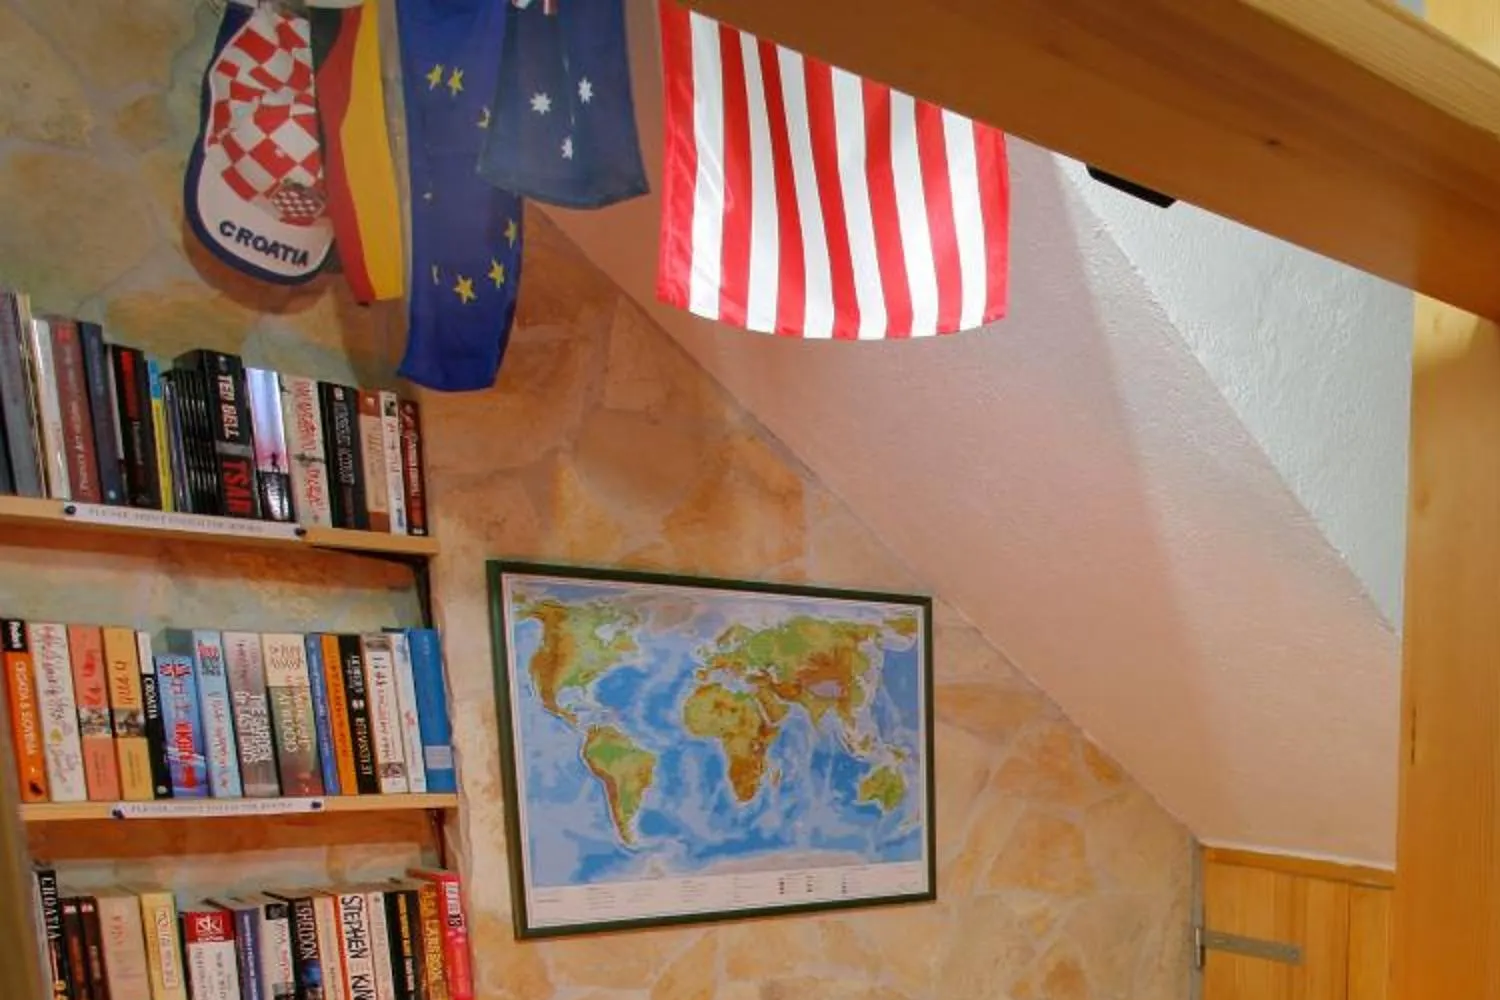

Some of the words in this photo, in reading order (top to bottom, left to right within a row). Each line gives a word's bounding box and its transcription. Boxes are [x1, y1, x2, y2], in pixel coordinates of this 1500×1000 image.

[219, 219, 309, 267] CROATIA
[41, 876, 62, 940] CROATIA
[341, 895, 369, 960] STEPHEN
